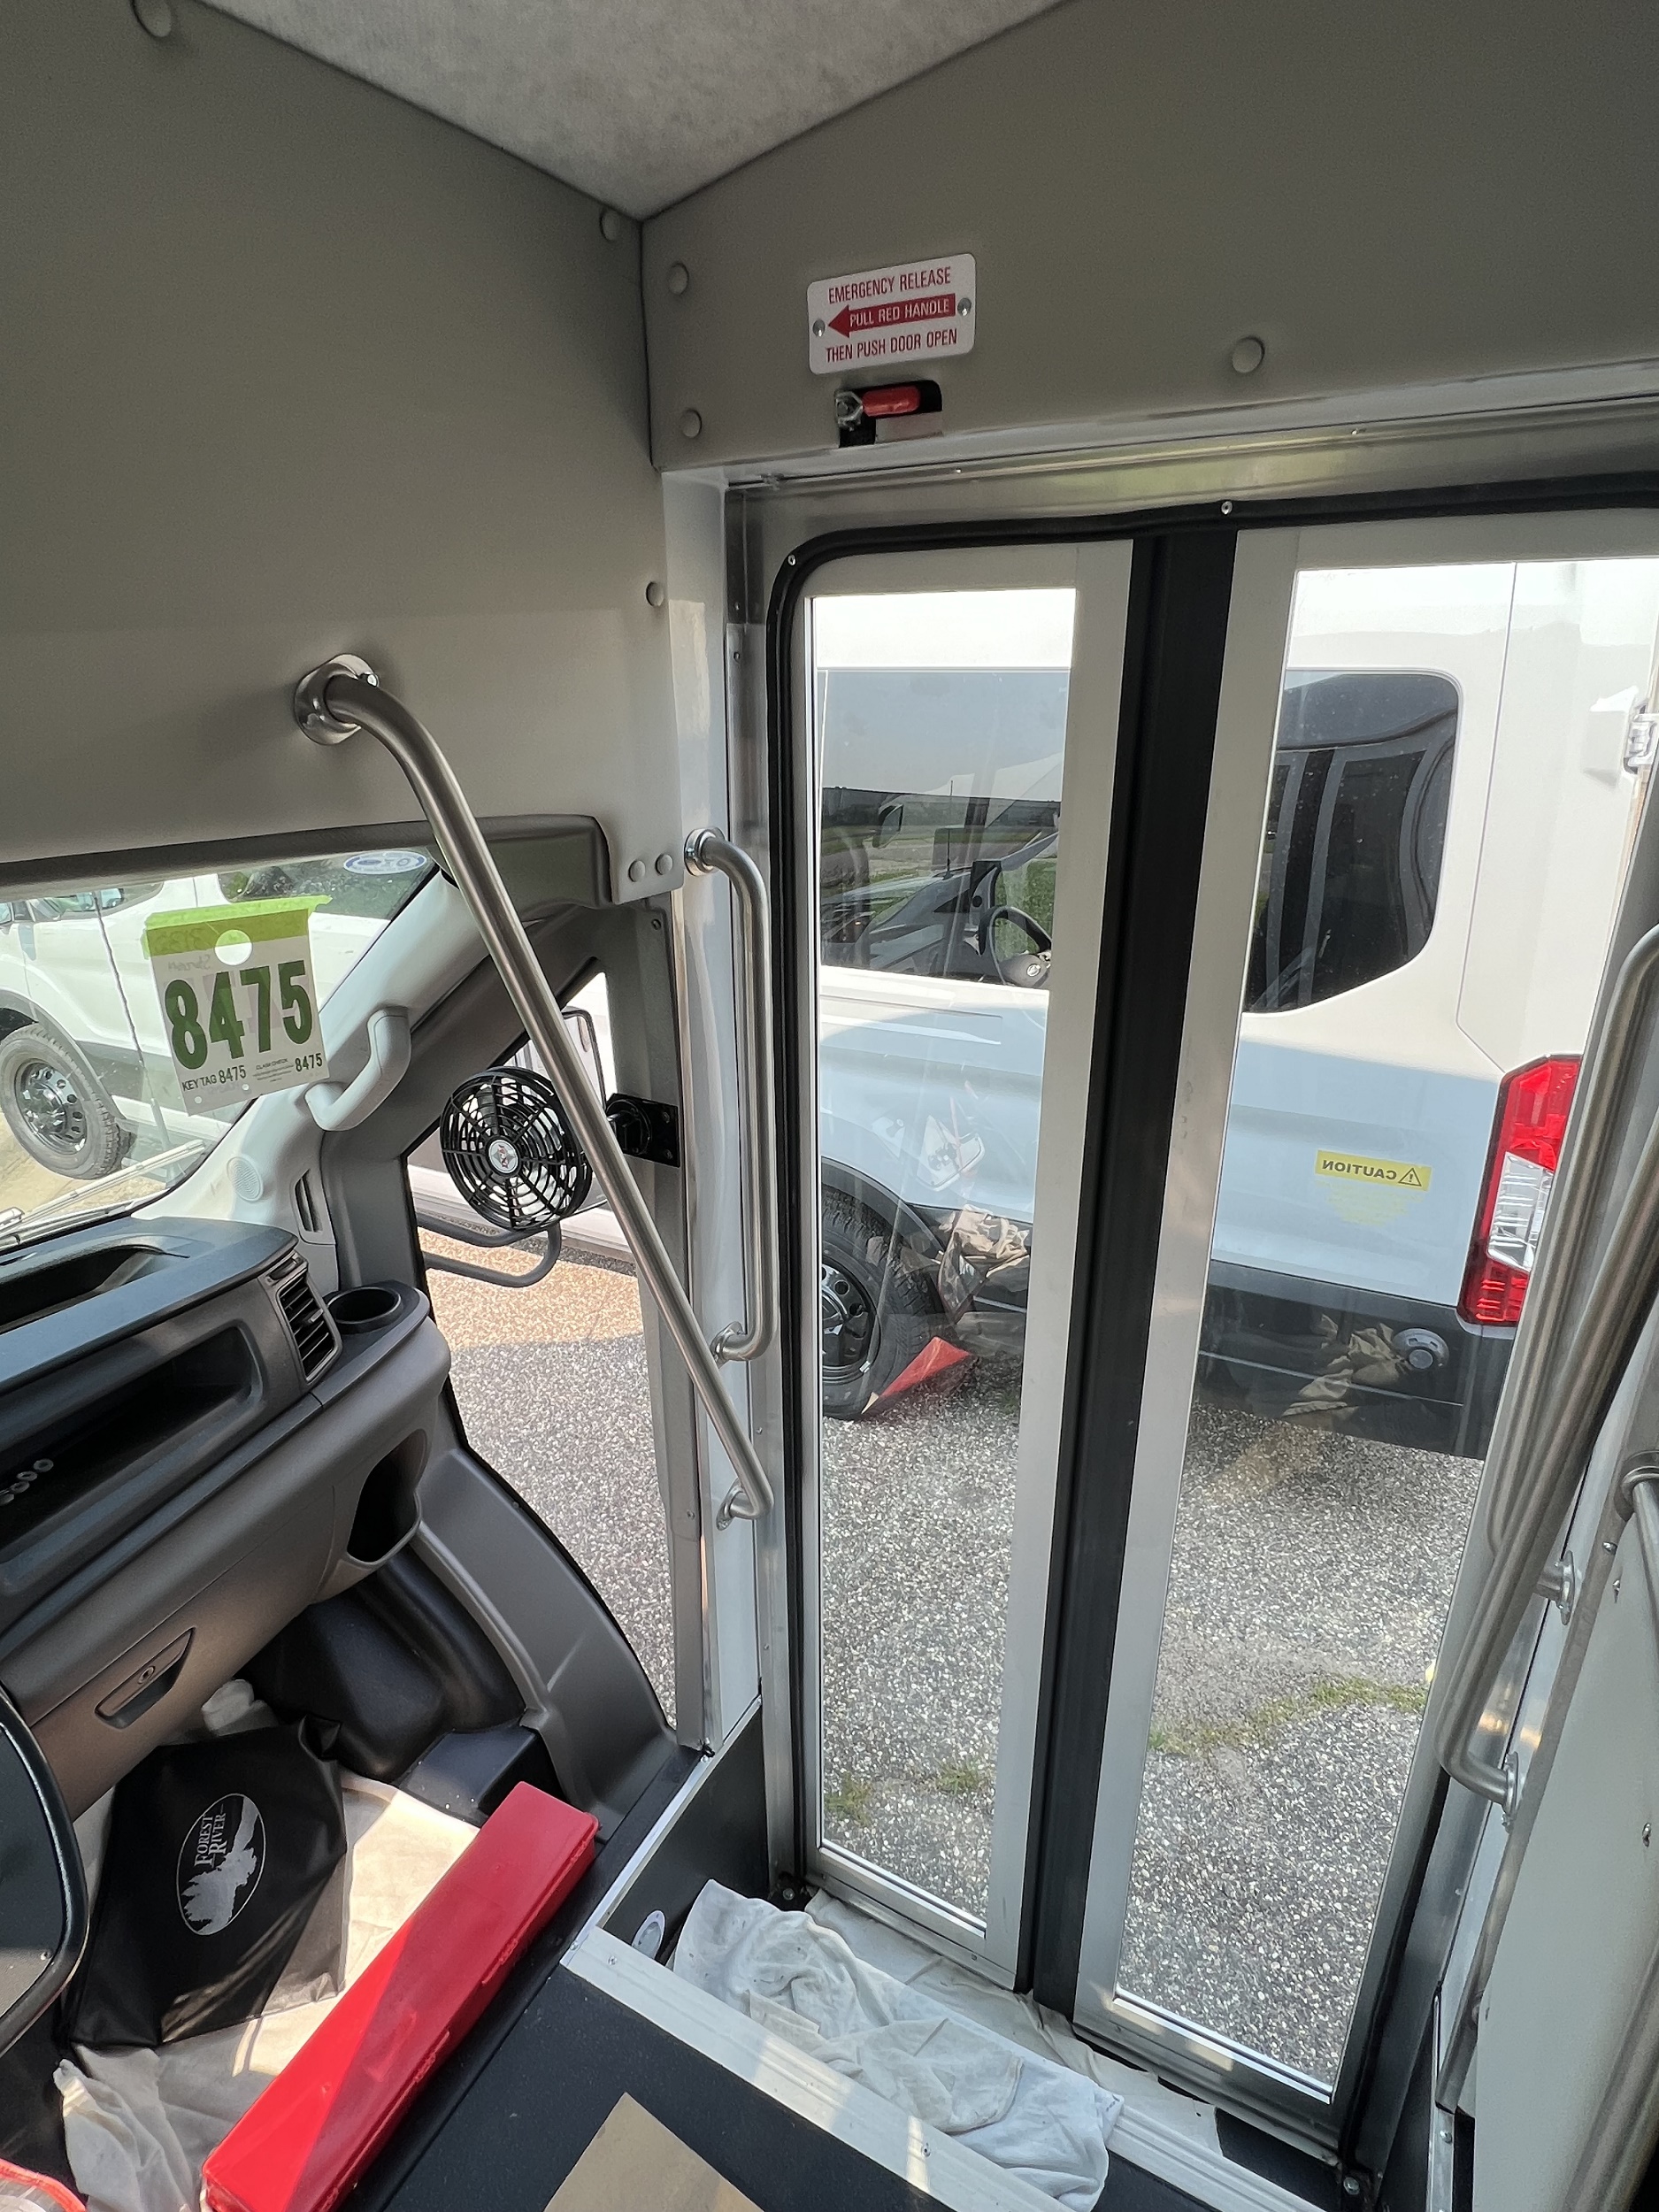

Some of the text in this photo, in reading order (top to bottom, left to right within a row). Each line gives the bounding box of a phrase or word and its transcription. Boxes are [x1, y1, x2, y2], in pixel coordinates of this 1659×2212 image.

[828, 266, 952, 304] EMERGENCY RELEASE
[849, 298, 950, 327] PULL RED HANDLE
[826, 327, 958, 364] THEN PUSH DOOR OPEN
[164, 959, 313, 1070] 8475
[181, 1077, 199, 1092] KEY
[199, 1074, 218, 1088] TAG
[218, 1064, 247, 1085] 8475
[295, 1052, 323, 1072] 8475
[194, 1815, 214, 1868] FOREST
[208, 1812, 228, 1855] RIVER
